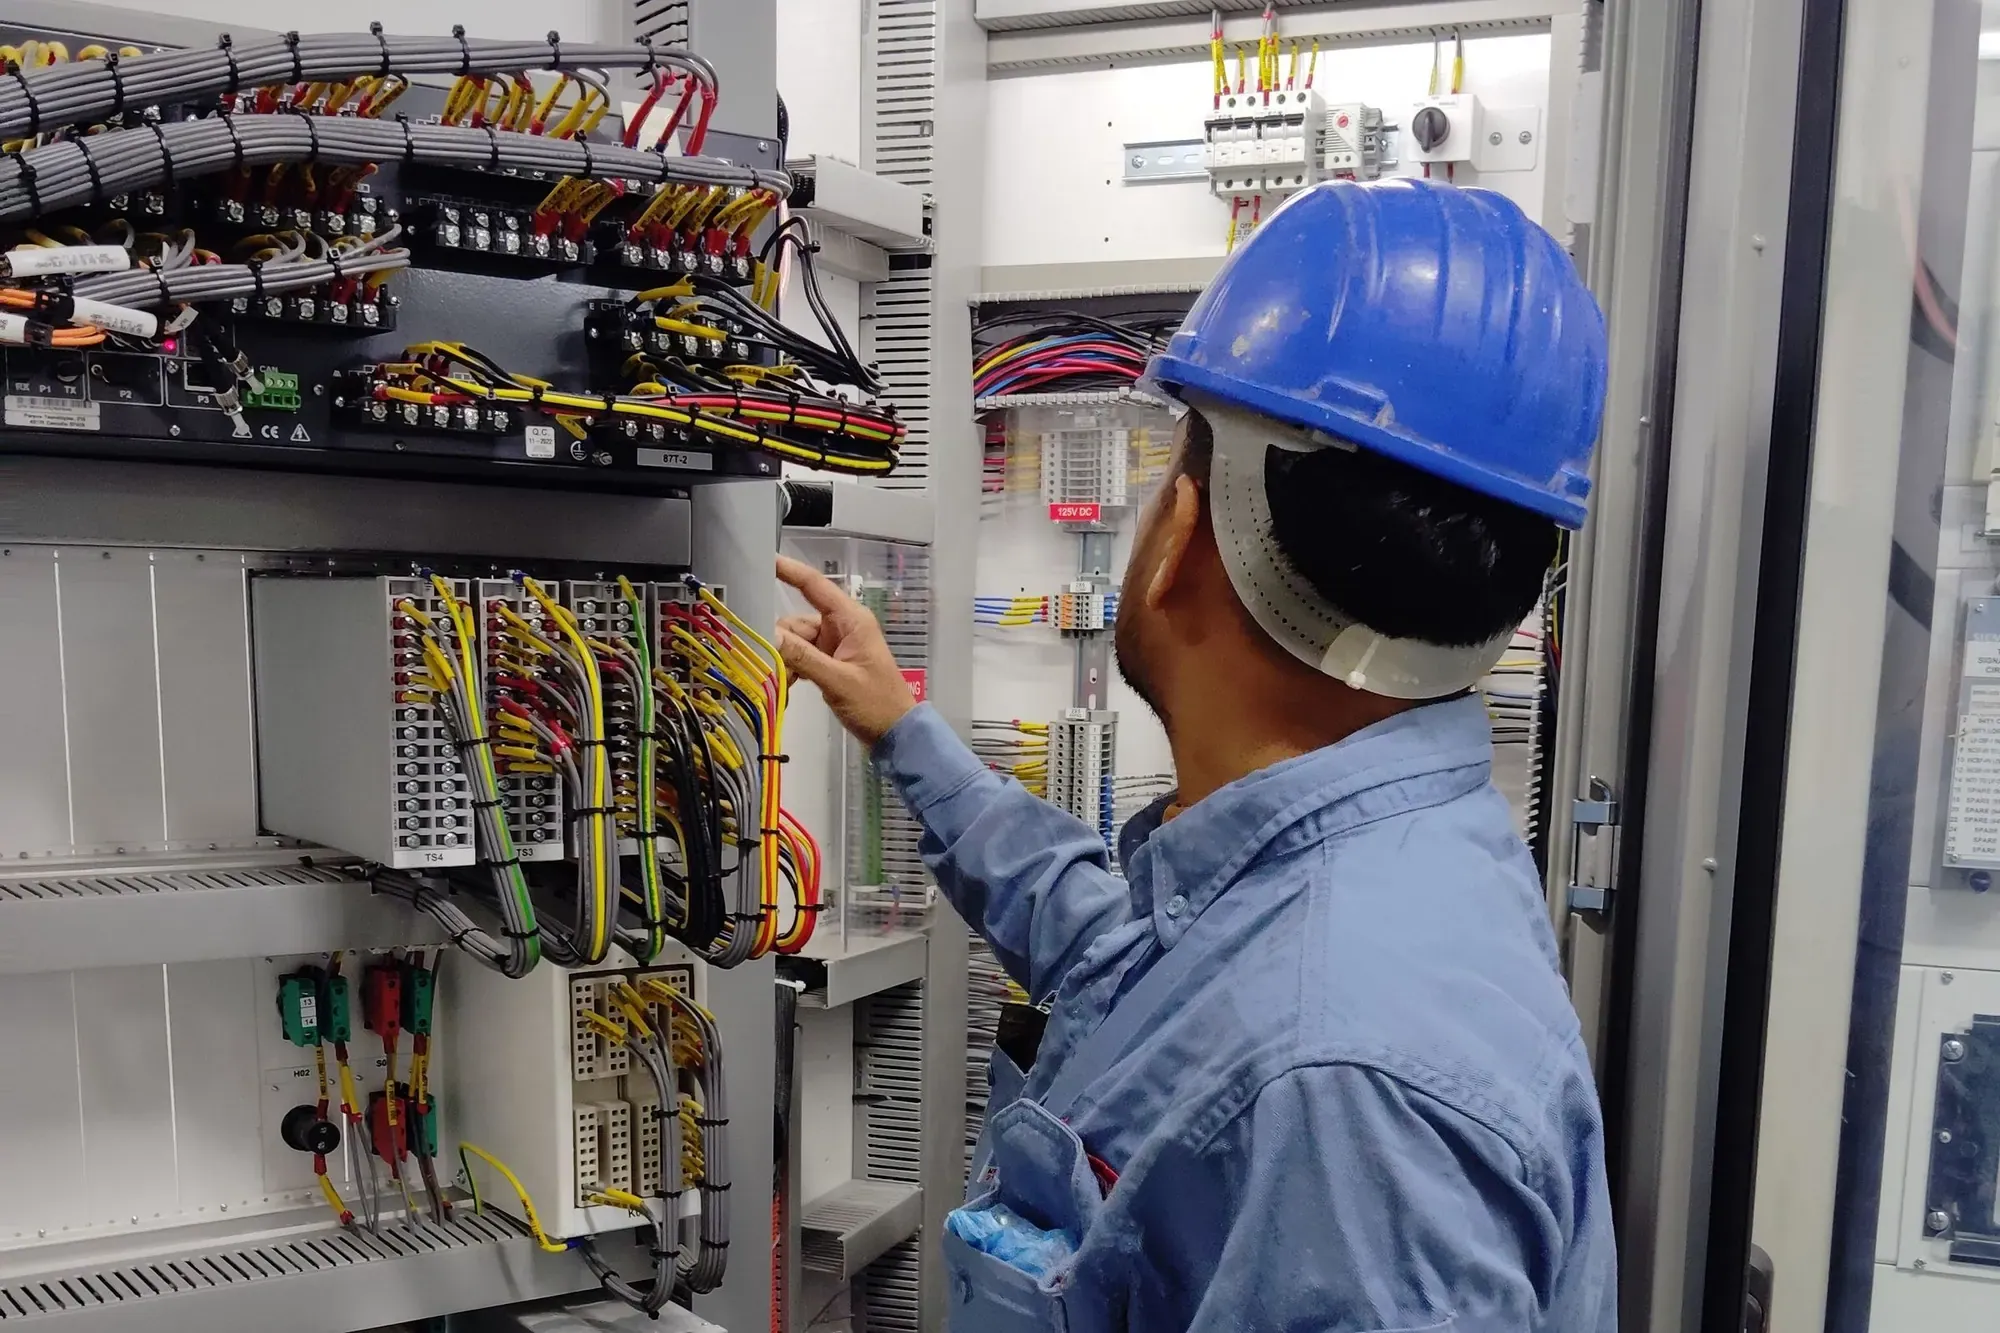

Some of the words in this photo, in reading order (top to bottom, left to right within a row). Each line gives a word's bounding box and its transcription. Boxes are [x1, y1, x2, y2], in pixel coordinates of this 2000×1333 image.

[39, 384, 52, 393] P1
[63, 385, 77, 395] TX
[119, 389, 133, 399] P2
[197, 395, 210, 404] P3
[662, 454, 688, 464] 87T-2
[1057, 507, 1078, 516] 125V
[1079, 507, 1093, 516] DC
[516, 848, 534, 858] TS3
[424, 853, 444, 863] TS4
[375, 1059, 388, 1068] S0
[293, 1069, 311, 1078] H02
